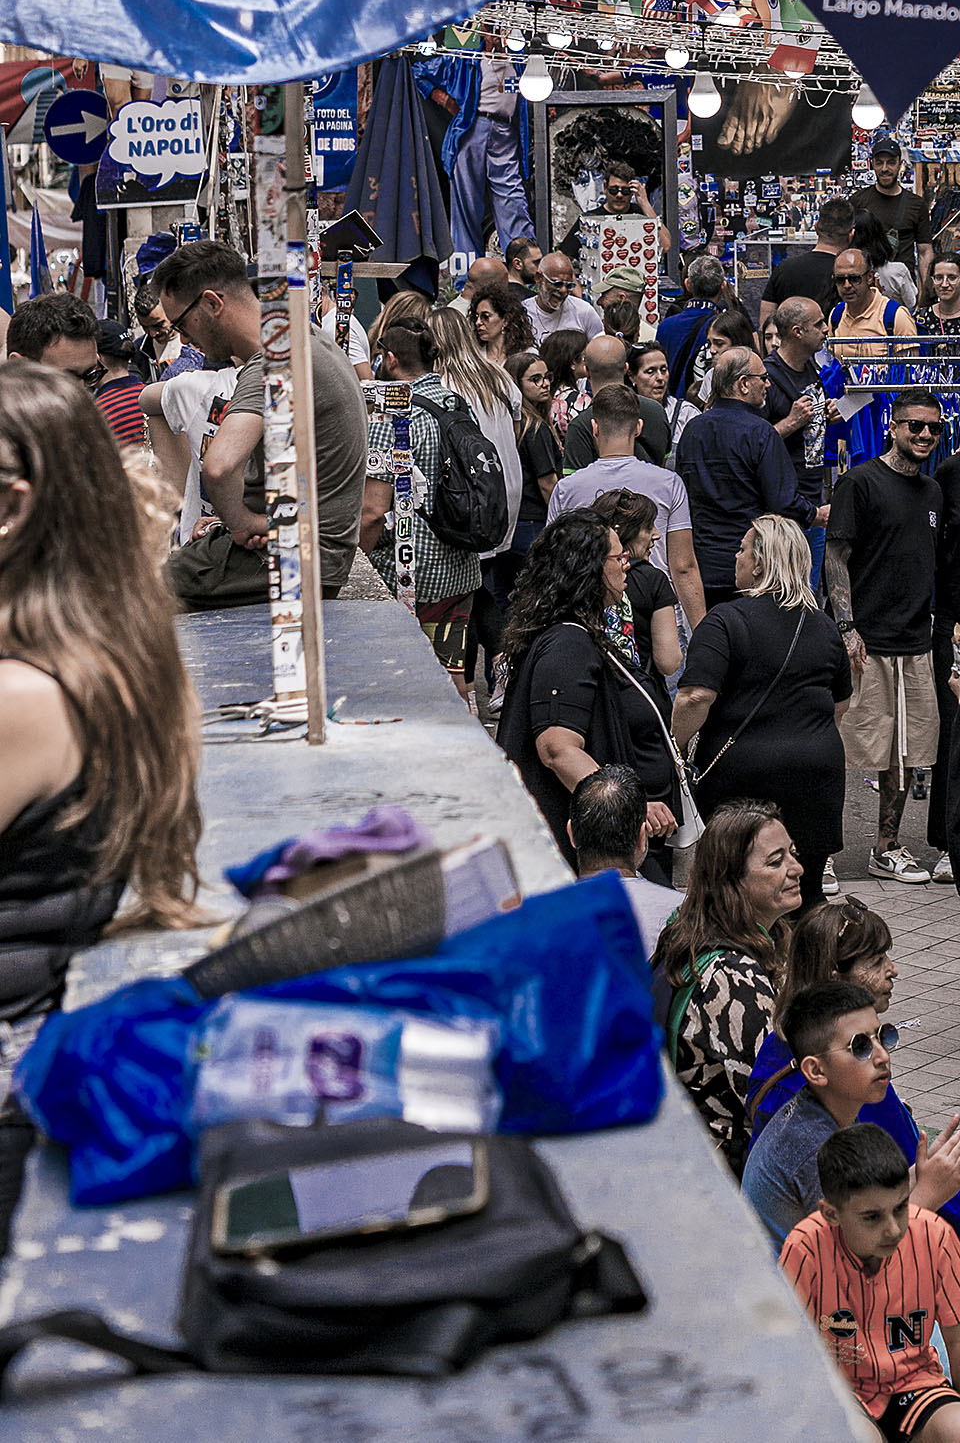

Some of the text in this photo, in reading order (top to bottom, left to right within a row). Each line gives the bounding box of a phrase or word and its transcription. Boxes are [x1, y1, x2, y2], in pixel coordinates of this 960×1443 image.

[127, 112, 199, 134] L'Oro di
[316, 109, 351, 119] FOTO DEL
[326, 121, 354, 131] PAGINA
[128, 136, 200, 158] NAPOLI
[317, 137, 356, 151] DE DIOS
[886, 1309, 928, 1354] N
